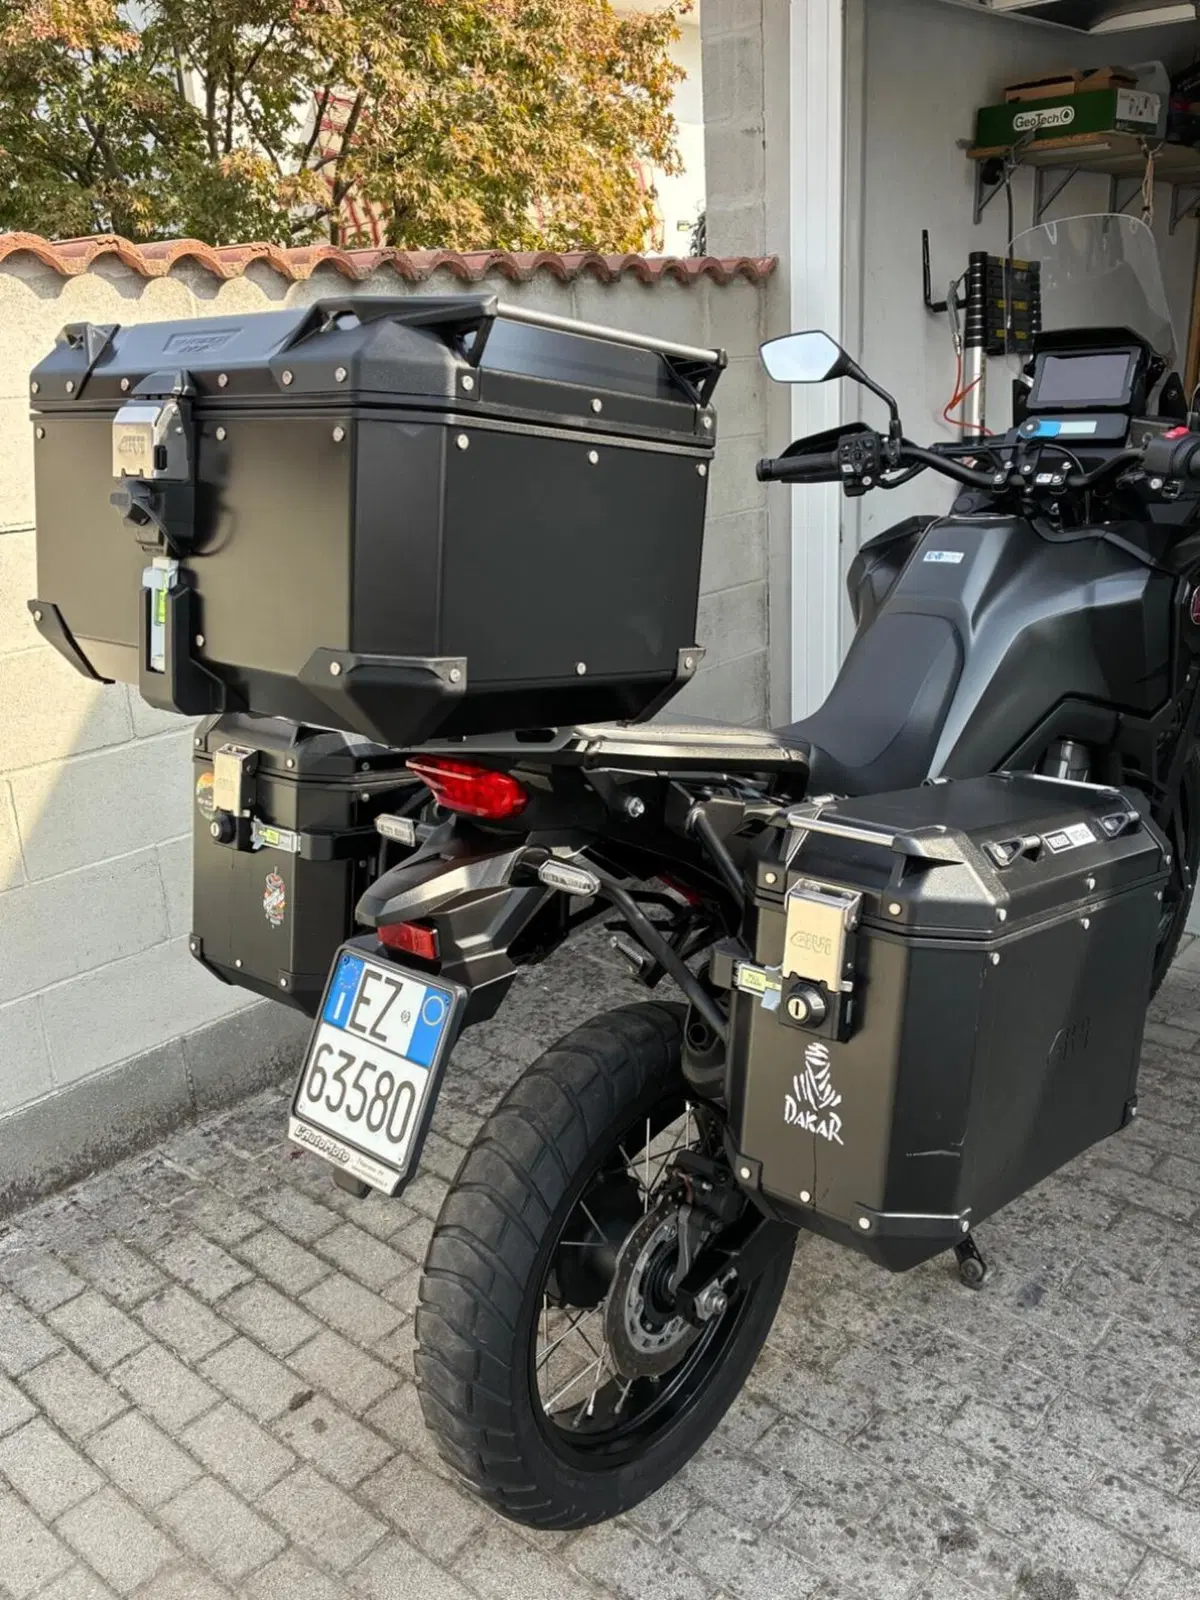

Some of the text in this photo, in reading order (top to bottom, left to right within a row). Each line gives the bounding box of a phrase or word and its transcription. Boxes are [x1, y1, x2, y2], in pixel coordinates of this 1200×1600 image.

[1015, 113, 1060, 128] GeoTech
[348, 968, 404, 1042] EZ
[306, 1043, 416, 1144] 63580
[784, 1094, 844, 1146] DAKAR
